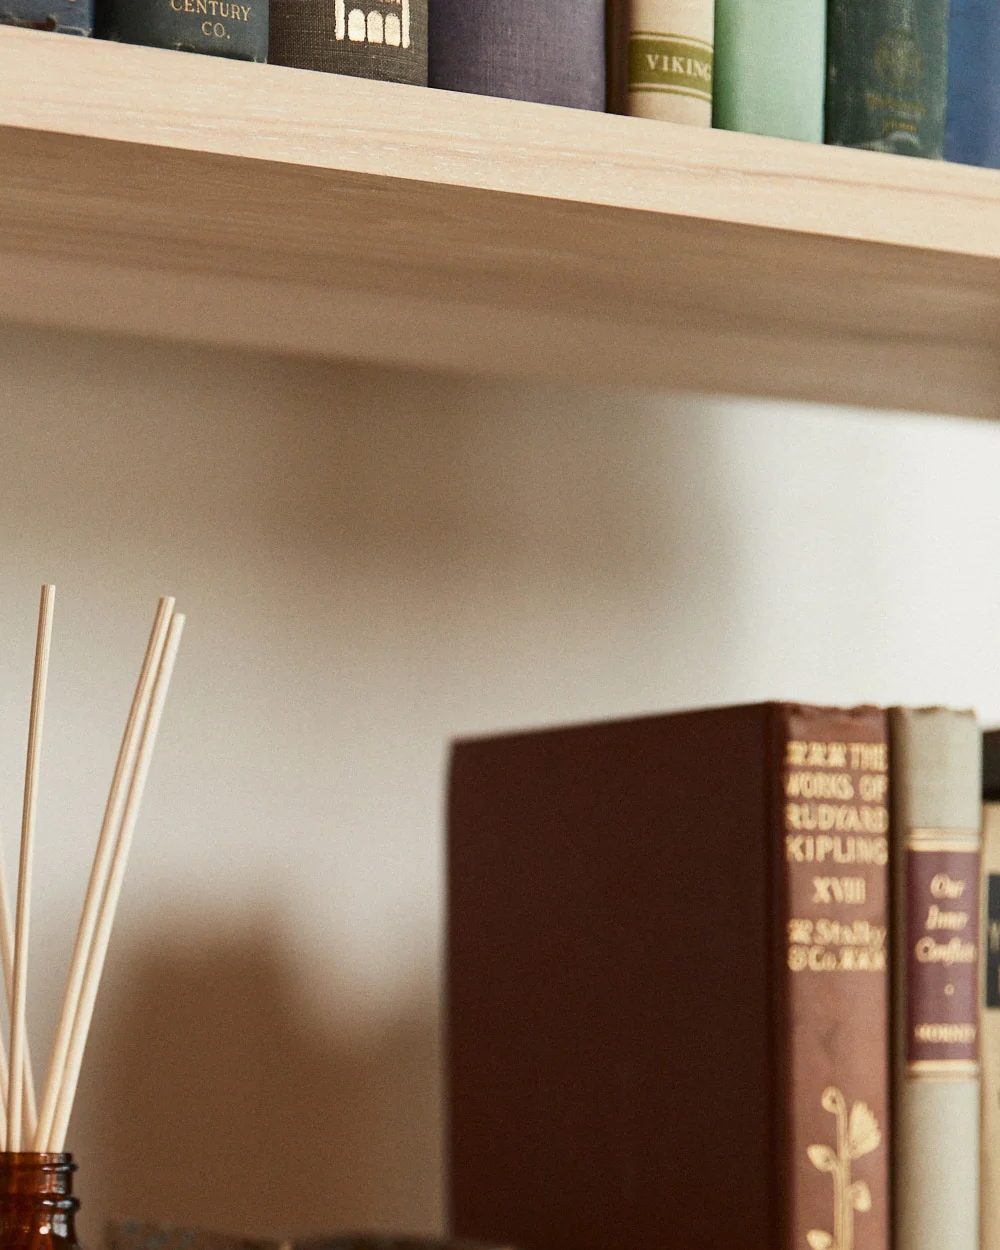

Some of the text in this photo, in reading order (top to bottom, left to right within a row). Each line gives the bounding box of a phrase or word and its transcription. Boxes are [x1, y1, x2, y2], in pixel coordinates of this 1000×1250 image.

[170, 0, 251, 21] CENTURY
[201, 21, 231, 40] CO.
[645, 53, 712, 81] VIKING
[785, 834, 888, 866] KIPLING
